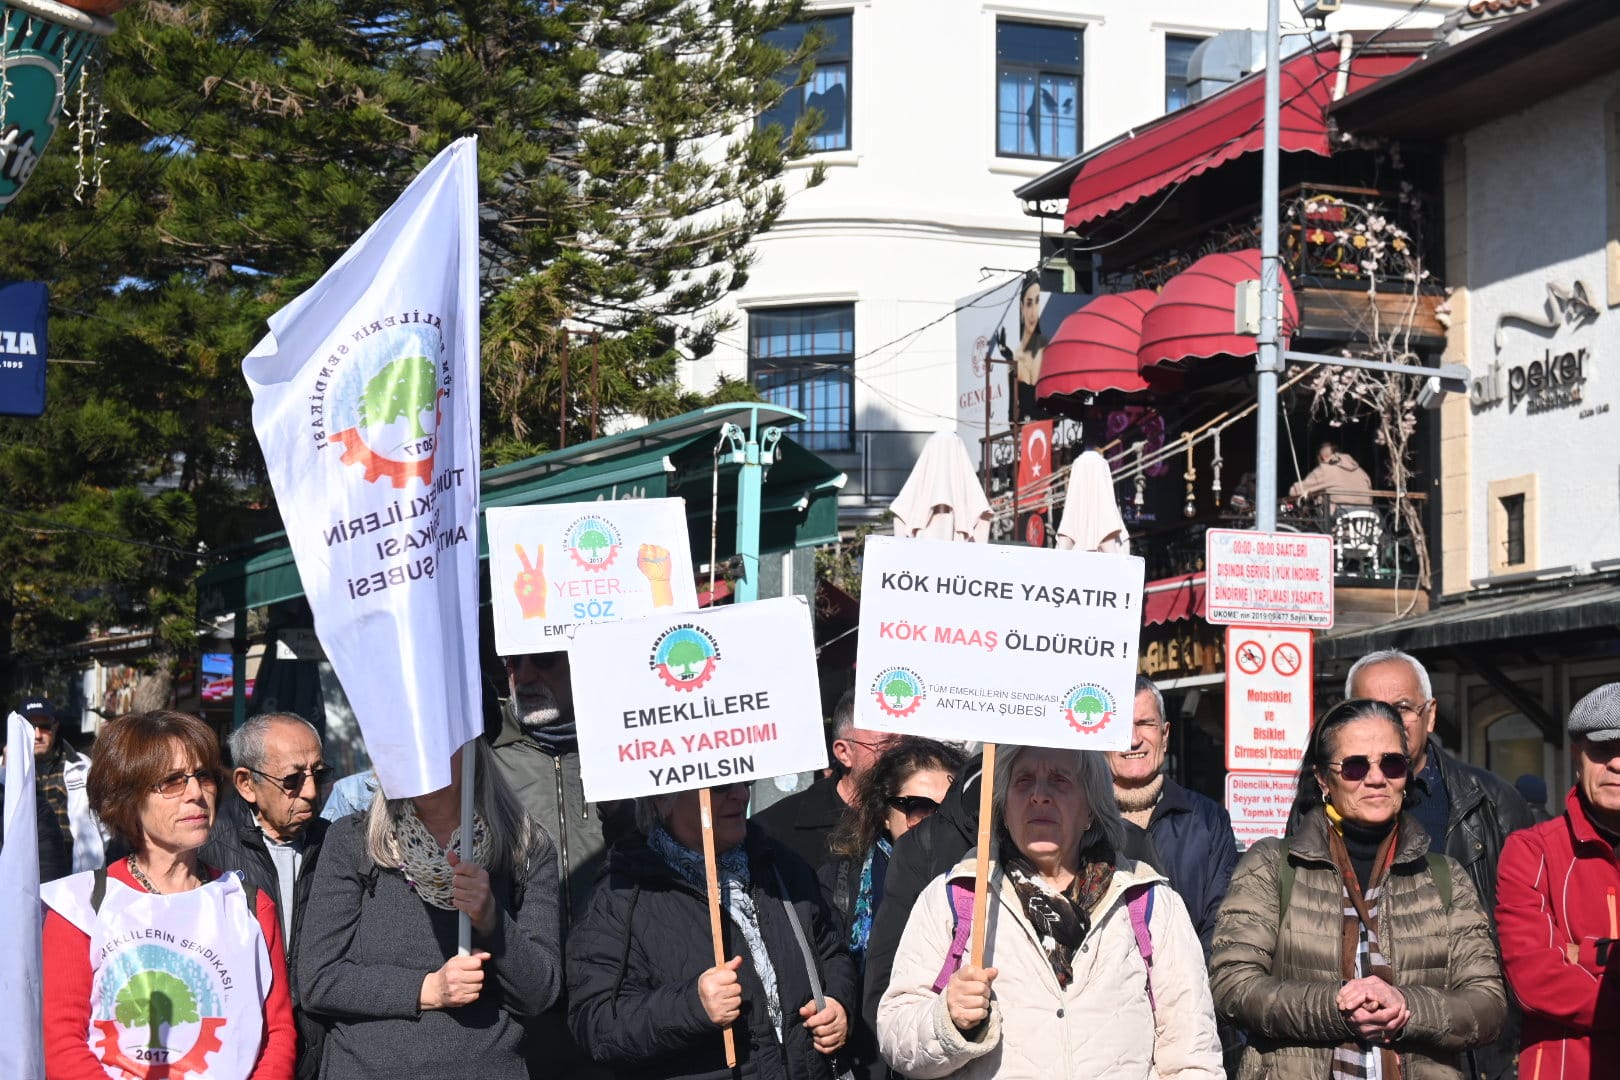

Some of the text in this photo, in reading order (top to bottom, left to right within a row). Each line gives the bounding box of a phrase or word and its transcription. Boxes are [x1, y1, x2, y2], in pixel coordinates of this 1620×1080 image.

[1508, 348, 1586, 413] peker
[881, 570, 1132, 610] KÖK HÜCRE YAŞATIR !
[573, 599, 616, 619] SÖZ
[879, 620, 928, 642] KÖK
[934, 626, 999, 652] MAAŞ
[1004, 629, 1116, 658] ÖLDÜRÜR
[1122, 641, 1129, 659] !
[929, 684, 1059, 703] TÜM EMEKLİLERİN SENDİKASI
[1247, 689, 1292, 703] Motosiklet
[623, 691, 770, 729] EMEKLİLERE
[936, 697, 1047, 717] ANTALYA ŞUBESİ
[1264, 711, 1275, 721] ve
[618, 722, 778, 762] KİRA YARDIMI
[1253, 727, 1286, 742] Bisiklet
[1234, 745, 1268, 759] Girmesi
[649, 755, 755, 786] YAPILSIN
[1233, 793, 1260, 805] Seyyar
[1242, 808, 1274, 818] Yapmak
[180, 939, 233, 992] SENDİKASI
[135, 1050, 169, 1062] 2017
